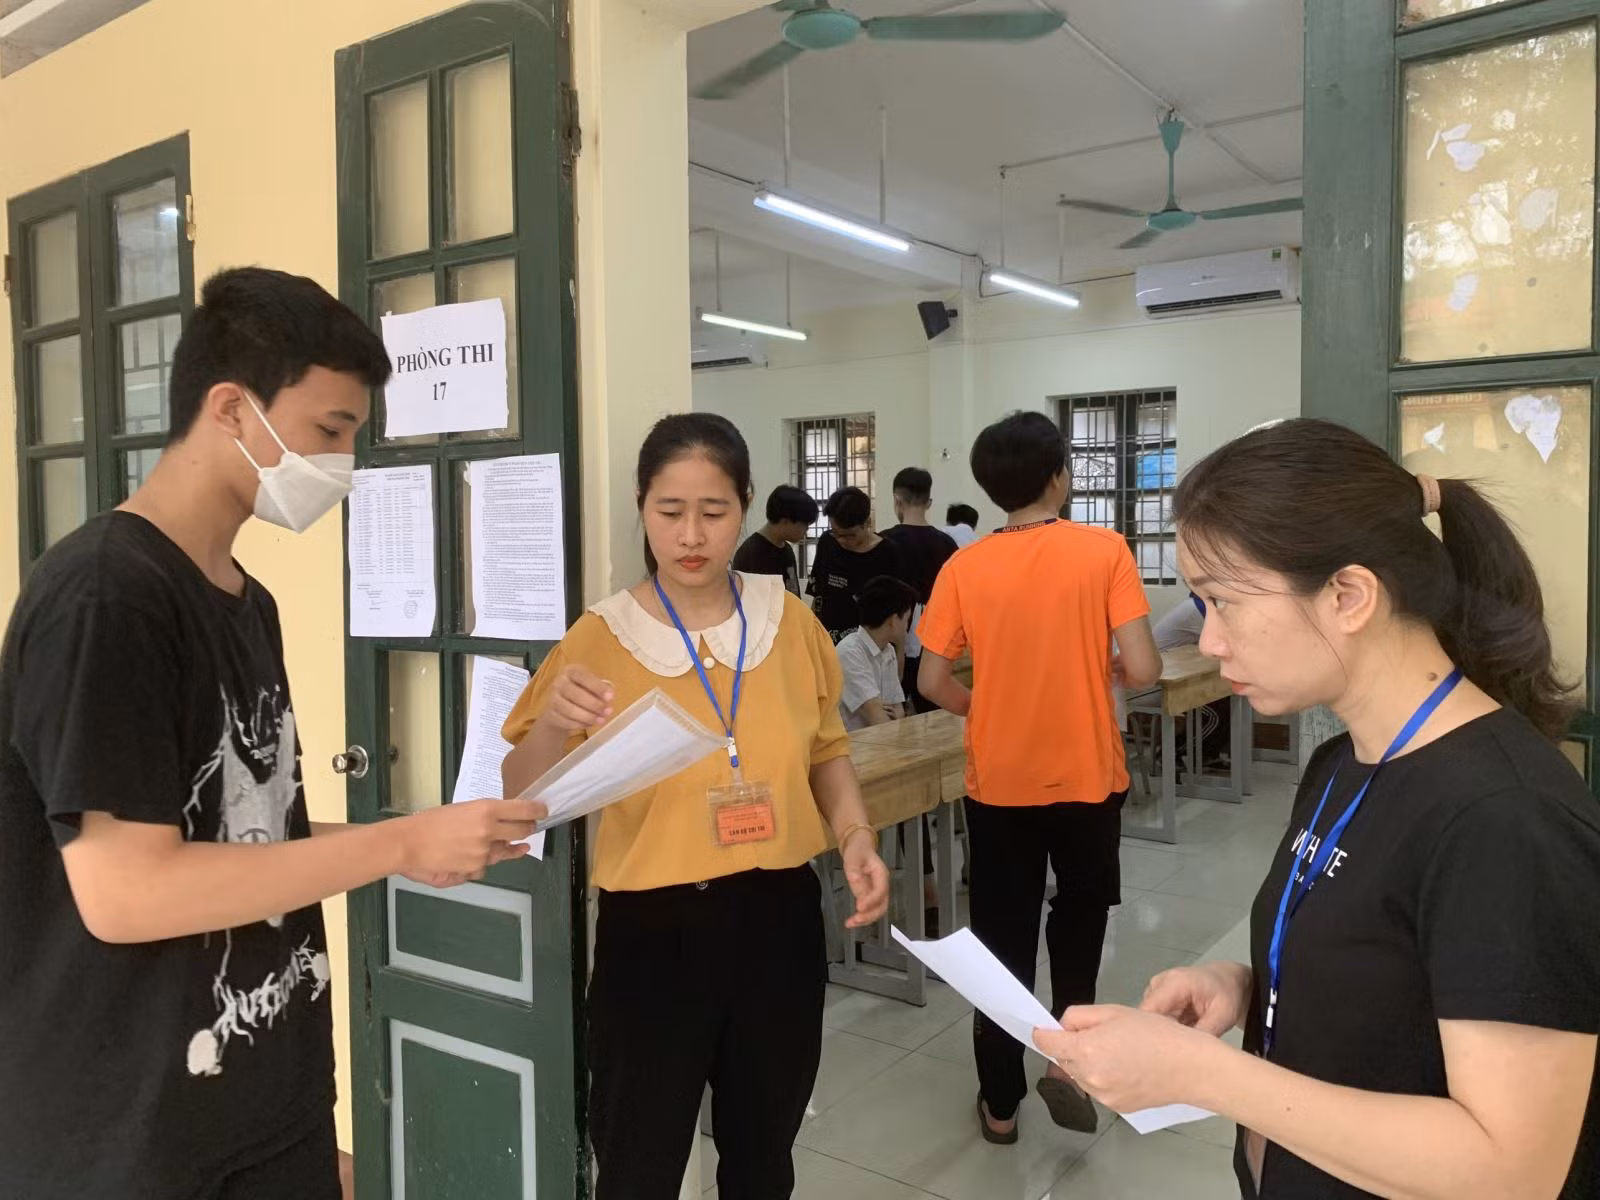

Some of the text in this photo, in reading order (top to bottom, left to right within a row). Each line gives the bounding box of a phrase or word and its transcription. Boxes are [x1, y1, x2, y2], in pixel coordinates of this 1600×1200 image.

[397, 344, 494, 373] PHÒNG THI
[433, 382, 447, 400] 17
[1291, 828, 1348, 878] WHTE
